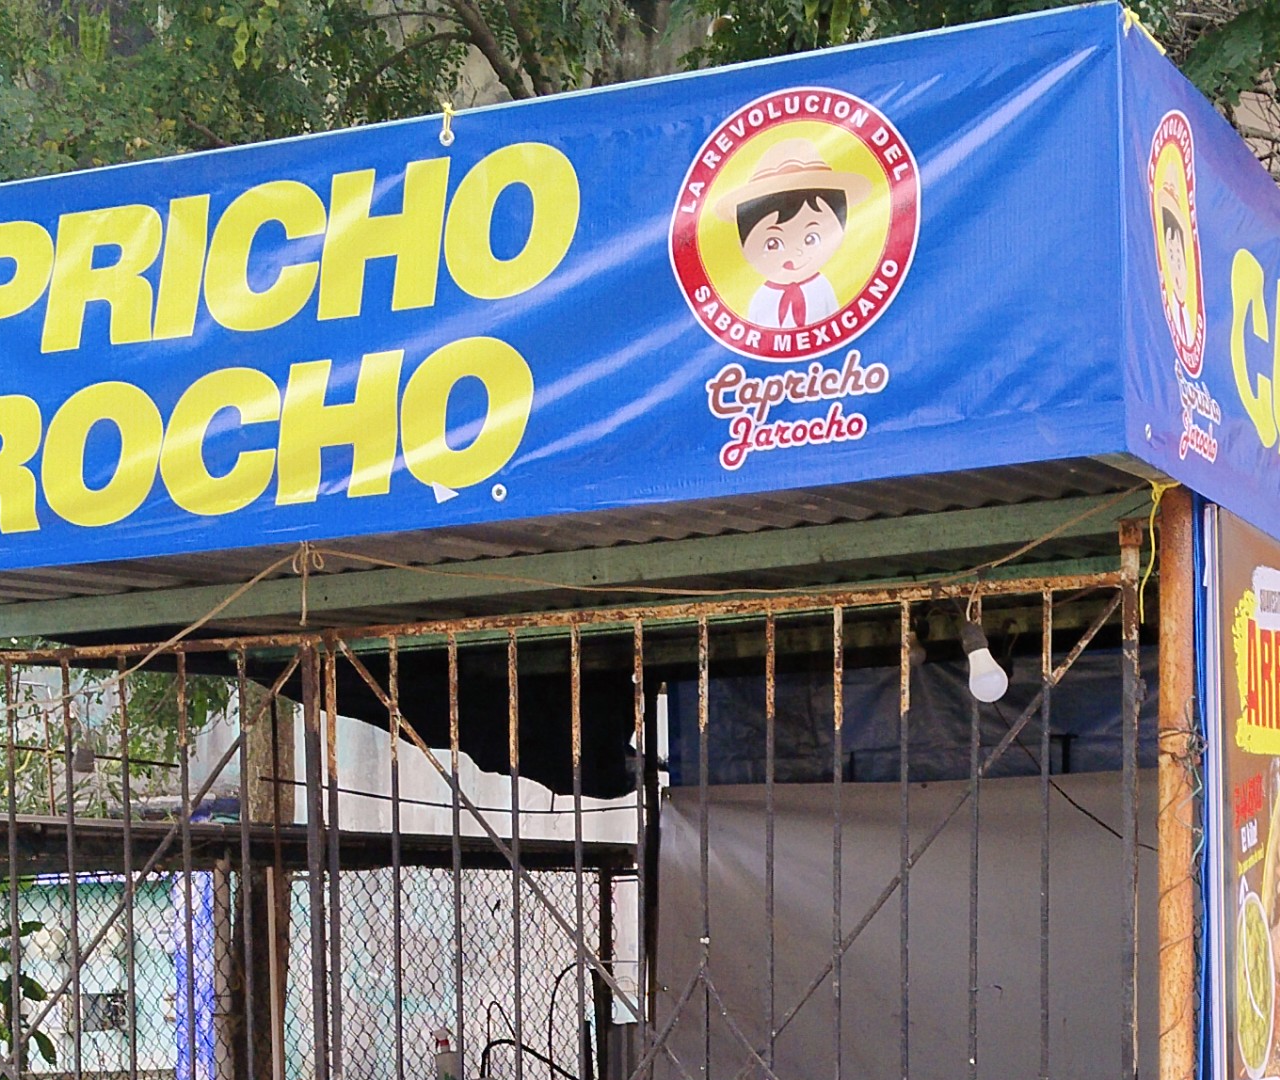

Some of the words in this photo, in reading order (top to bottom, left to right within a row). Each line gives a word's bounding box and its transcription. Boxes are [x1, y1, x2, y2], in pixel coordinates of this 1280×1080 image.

[680, 179, 705, 215] LA
[702, 94, 870, 170] REVOLUCION
[870, 124, 912, 182] DEL
[693, 284, 761, 350] SABOR
[772, 257, 900, 353] MEXICANO
[707, 349, 887, 423] Capricho
[721, 403, 865, 468] Jarocho
